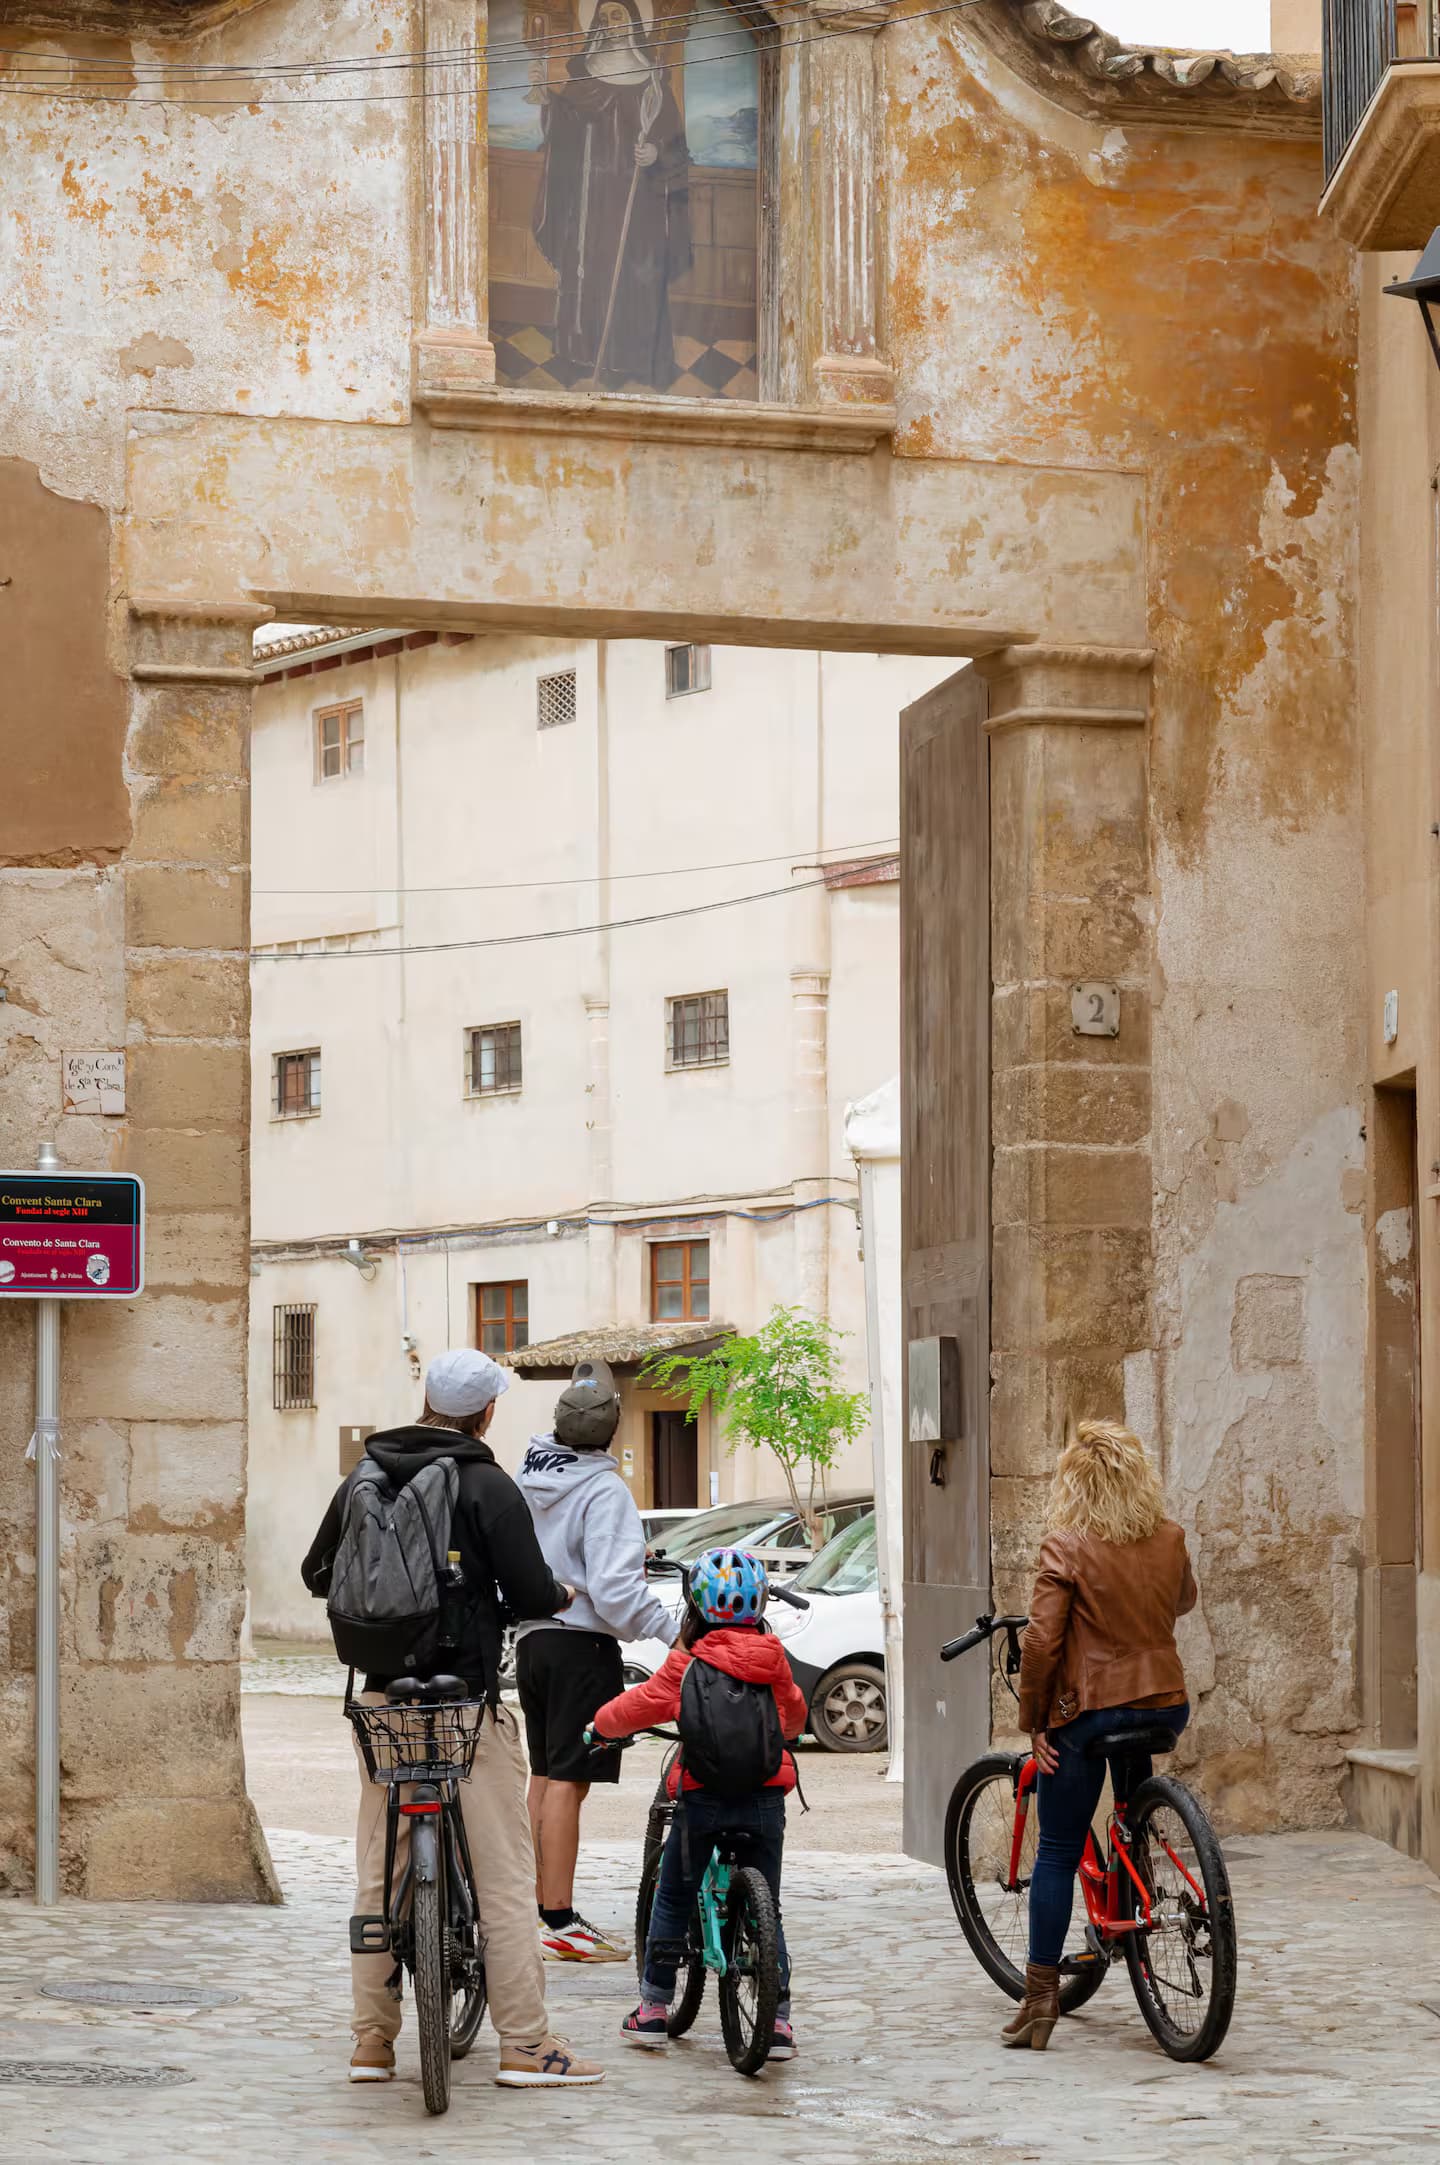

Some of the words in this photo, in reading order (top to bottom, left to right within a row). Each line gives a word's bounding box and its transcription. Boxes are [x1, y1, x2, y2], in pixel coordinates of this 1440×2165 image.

[1089, 993, 1104, 1023] 2
[1, 1195, 42, 1206] Convent
[44, 1196, 72, 1207] Santa
[74, 1197, 102, 1207] Clara
[72, 1207, 89, 1217] XIII
[2, 1237, 42, 1248] Convento
[43, 1238, 53, 1248] de
[54, 1239, 77, 1249] Santa
[78, 1239, 100, 1248] Clara
